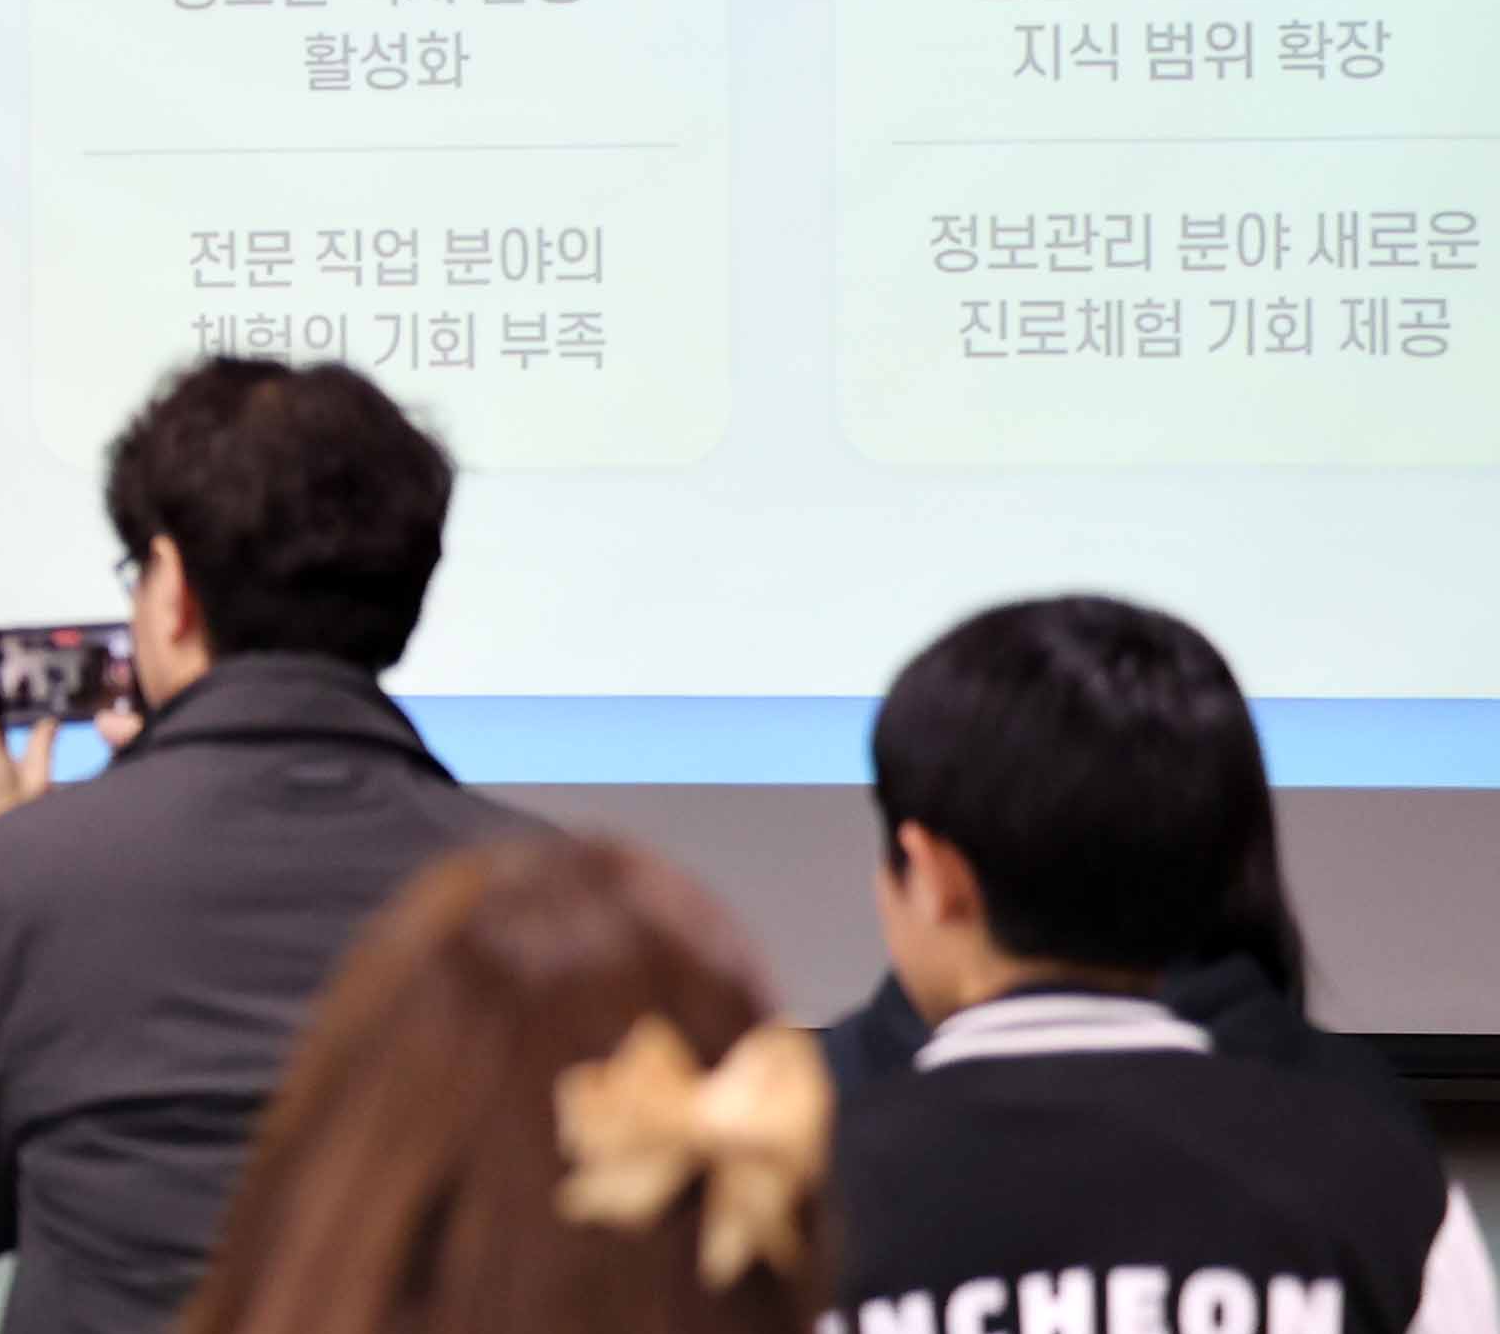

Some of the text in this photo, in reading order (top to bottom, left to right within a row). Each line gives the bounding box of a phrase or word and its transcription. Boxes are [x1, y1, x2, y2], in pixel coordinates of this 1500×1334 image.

[303, 29, 471, 92] 활성화
[1013, 19, 1392, 82] 지식 범위 확장
[189, 226, 603, 289] 전문 직업 분야의
[930, 210, 1481, 274] 정보관리 분야 새로운
[373, 311, 476, 370] 기회
[499, 310, 607, 371] 부족
[959, 295, 1452, 359] 진로체험 기회 제공
